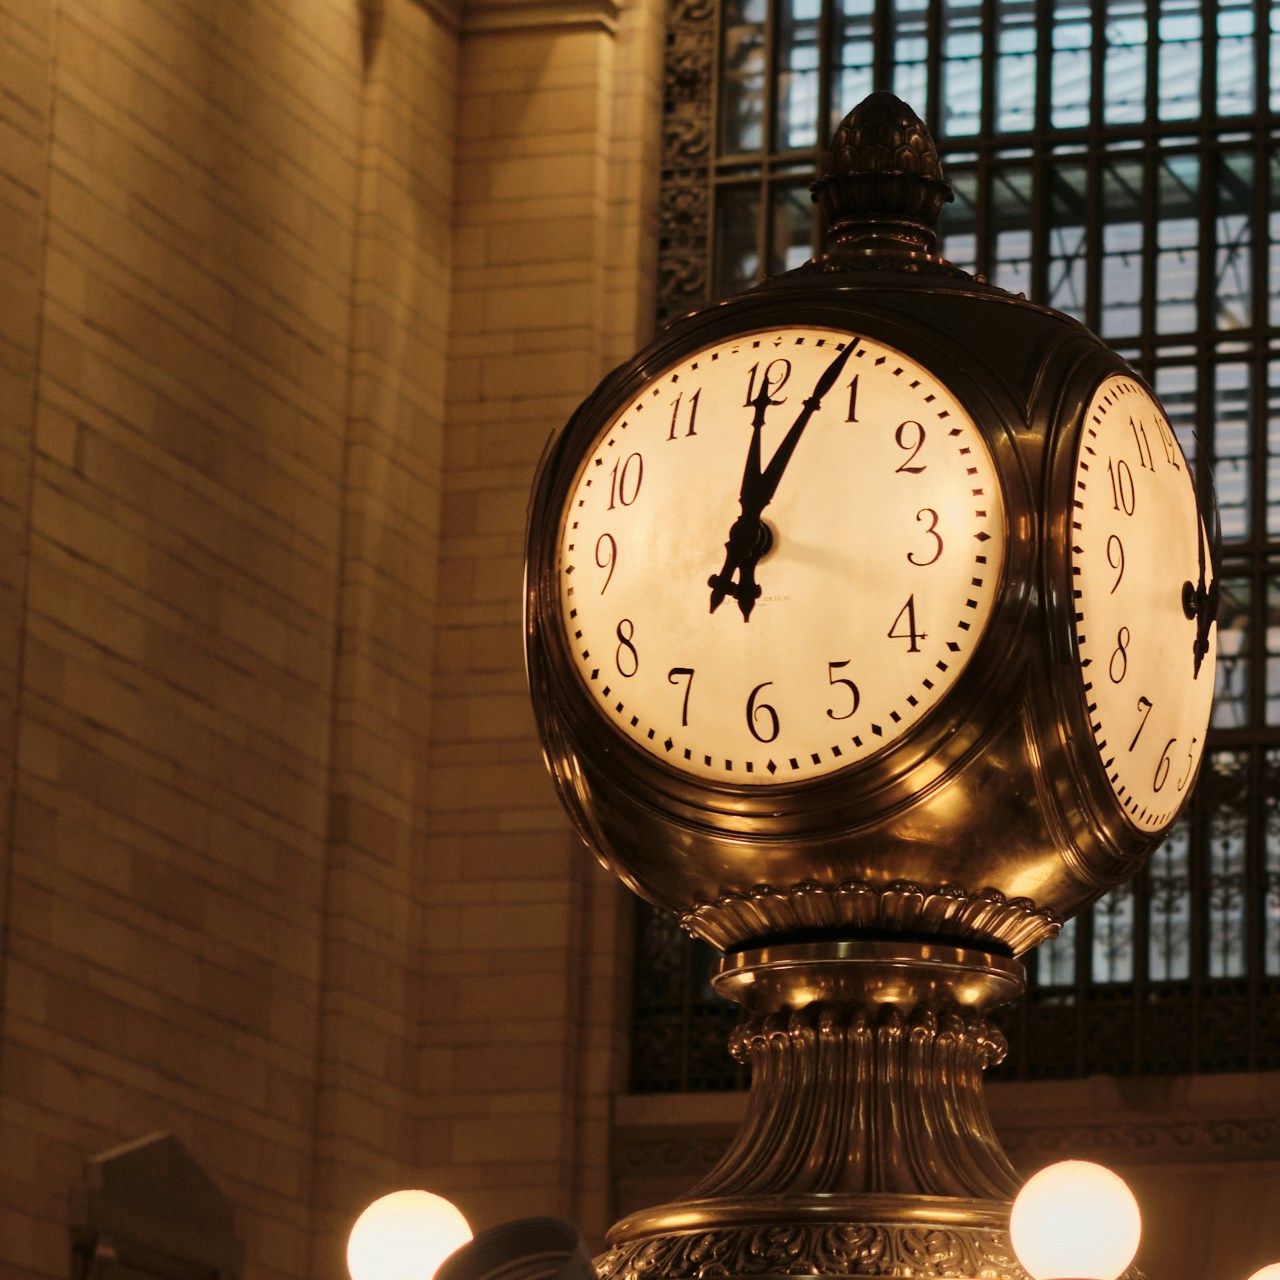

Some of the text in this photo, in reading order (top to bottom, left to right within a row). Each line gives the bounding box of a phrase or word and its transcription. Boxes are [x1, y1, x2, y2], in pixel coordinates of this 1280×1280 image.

[746, 358, 792, 409] 12
[846, 374, 860, 423] 1
[666, 387, 702, 442] 11
[895, 420, 927, 474] 2
[1129, 417, 1155, 472] 11
[607, 452, 645, 511] 10
[1108, 457, 1136, 516] 10
[595, 533, 617, 595] 9
[906, 508, 944, 566] 3
[1106, 534, 1125, 595] 9
[615, 619, 640, 678] 8
[887, 594, 928, 652] 4
[1109, 626, 1130, 684] 8
[667, 667, 695, 727] 7
[745, 682, 780, 743] 6
[827, 661, 861, 720] 5
[1129, 695, 1153, 753] 7
[1153, 737, 1178, 794] 6
